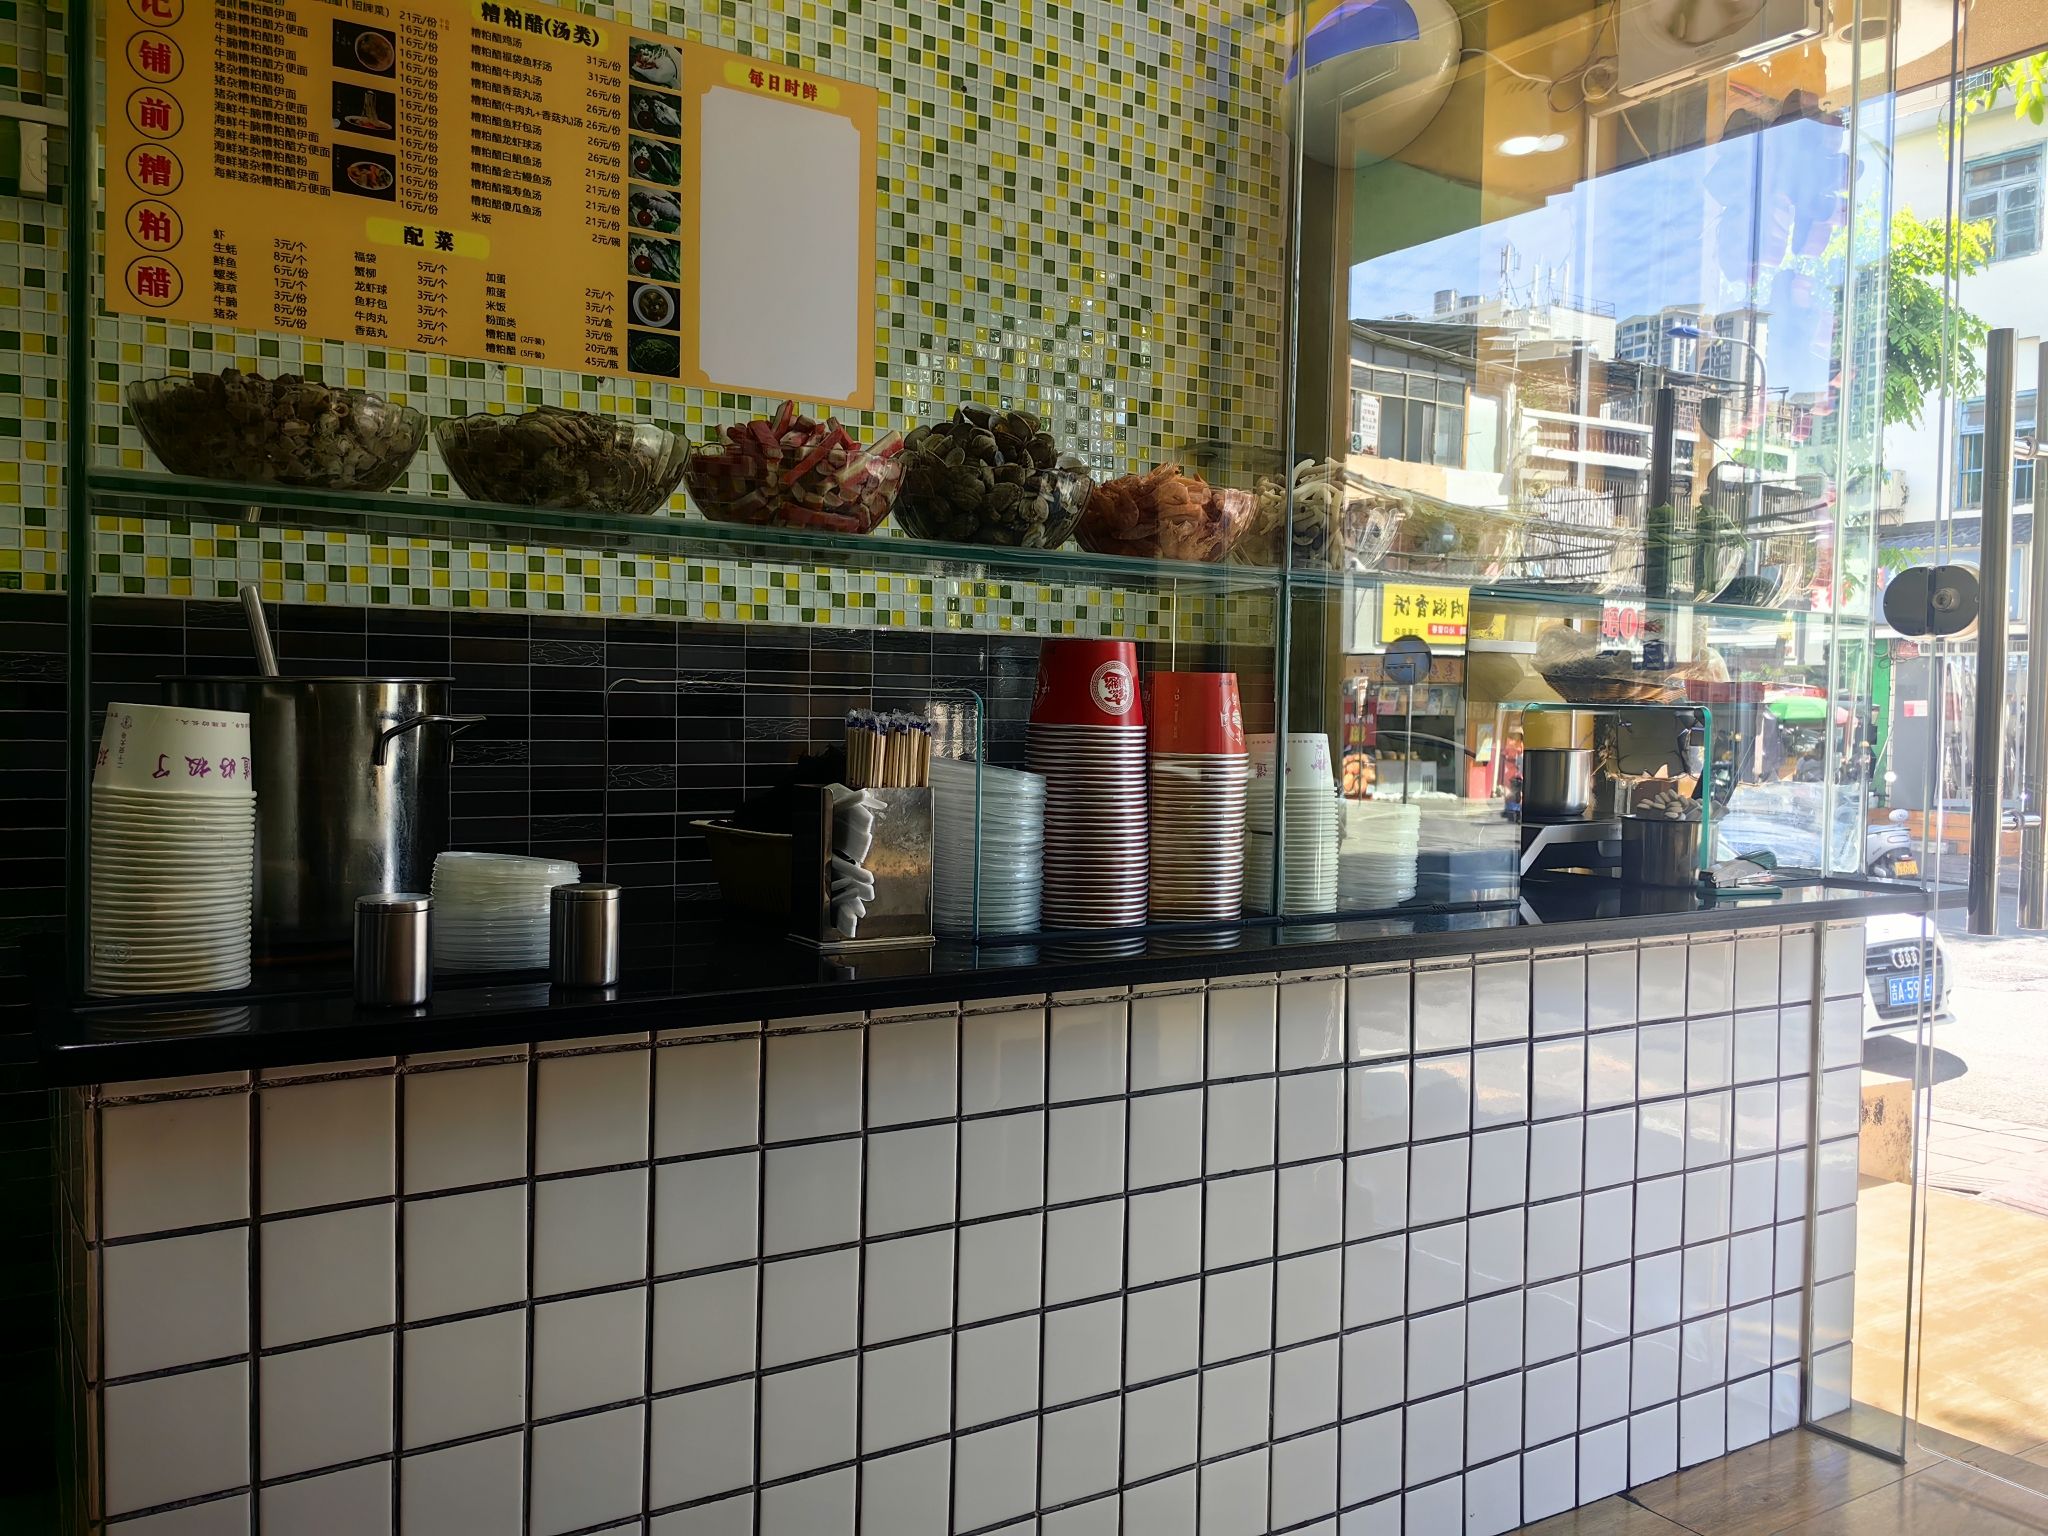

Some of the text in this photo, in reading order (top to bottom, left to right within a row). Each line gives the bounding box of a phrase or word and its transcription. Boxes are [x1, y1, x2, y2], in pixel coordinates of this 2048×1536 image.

[399, 11, 437, 27] 21元/份
[481, 2, 600, 47] 糟粕醋(汤类)
[400, 24, 438, 40] 16元/份
[400, 36, 438, 52] 16元/份
[400, 49, 438, 64] 16元/份
[586, 55, 621, 72] 31元/份
[400, 61, 438, 77] 16元/份
[400, 74, 438, 90] 16元/份
[588, 72, 621, 88] 31元/份
[748, 68, 818, 101] 每日时鲜
[400, 86, 438, 102] 16元/份
[586, 88, 621, 104] 26元/份
[400, 99, 438, 115] 16元/份
[586, 104, 621, 120] 26元/份
[400, 112, 438, 127] 16元/份
[400, 124, 438, 140] 16元/份
[586, 121, 621, 136] 26元/份
[400, 137, 438, 153] 16元/份
[587, 137, 621, 152] 26元/份
[400, 149, 438, 165] 16元/份
[587, 153, 621, 168] 26元/份
[400, 162, 438, 178] 16元/份
[585, 168, 621, 183] 21元/份
[400, 175, 438, 191] 16元/份
[400, 187, 438, 203] 16元/份
[586, 184, 621, 200] 21元/份
[400, 200, 438, 216] 16元/份
[586, 201, 621, 216] 21元/份
[586, 217, 621, 232] 21元/份
[213, 229, 307, 252] 虾 3元/个
[403, 225, 454, 252] 配菜
[213, 243, 307, 265] 生蚝 8元/个
[213, 256, 309, 279] 鲜鱼 6元/份
[354, 251, 448, 275] 福袋 5元/个
[274, 278, 307, 291] 1元/个
[354, 266, 448, 289] 蟹柳 3元/个
[213, 281, 307, 304] 海草 3元/份
[354, 281, 448, 303] 龙虾球 3元/个
[486, 272, 615, 301] 加蛋 2元/个
[213, 295, 307, 317] 牛腩 8元/份
[354, 295, 448, 318] 鱼籽包 3元/个
[486, 286, 615, 315] 煎蛋 3元/个
[213, 308, 307, 329] 猪杂 5元/份
[354, 310, 448, 332] 牛肉丸 3元/个
[486, 300, 613, 329] 米饭 3元/盒
[354, 325, 448, 347] 香菇丸 2元/个
[486, 314, 613, 342] 粉面类 3元/份
[585, 343, 619, 356] 20元/瓶
[585, 356, 619, 369] 45元/瓶
